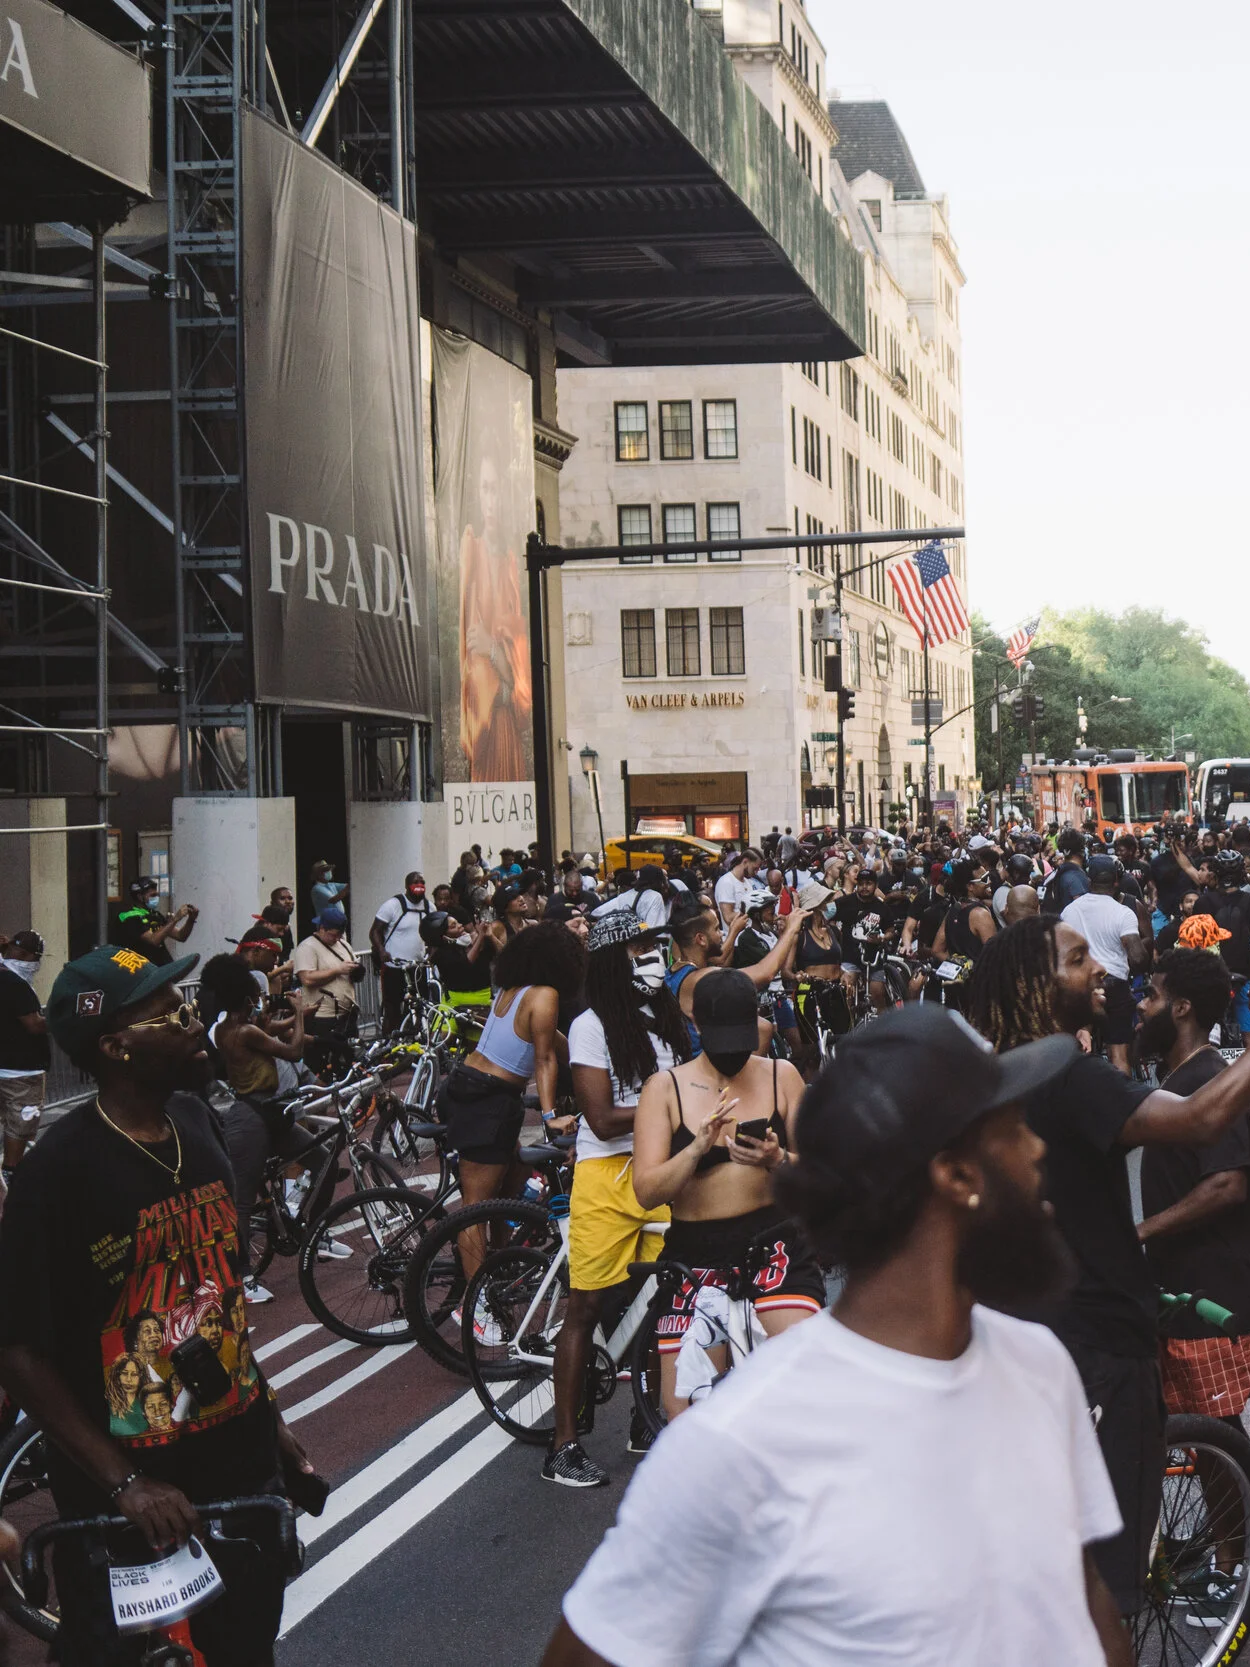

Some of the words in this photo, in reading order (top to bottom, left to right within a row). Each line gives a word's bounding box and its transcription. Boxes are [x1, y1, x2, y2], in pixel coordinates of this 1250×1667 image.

[0, 16, 39, 99] A
[265, 511, 421, 628] PRADA
[626, 693, 648, 709] VAN
[650, 693, 688, 708] CLEEF
[690, 693, 698, 708] &
[700, 691, 745, 708] ARPELS
[1212, 768, 1228, 776] 2437
[453, 793, 534, 826] BVLGAR
[136, 1179, 229, 1231] MILLION
[135, 1198, 239, 1267] WOMAN
[111, 1570, 147, 1580] BLACK
[111, 1576, 150, 1588] LIVES
[117, 1591, 179, 1620] RAYSHARD
[179, 1566, 216, 1601] BROOKS
[1217, 1621, 1247, 1667] MAX
